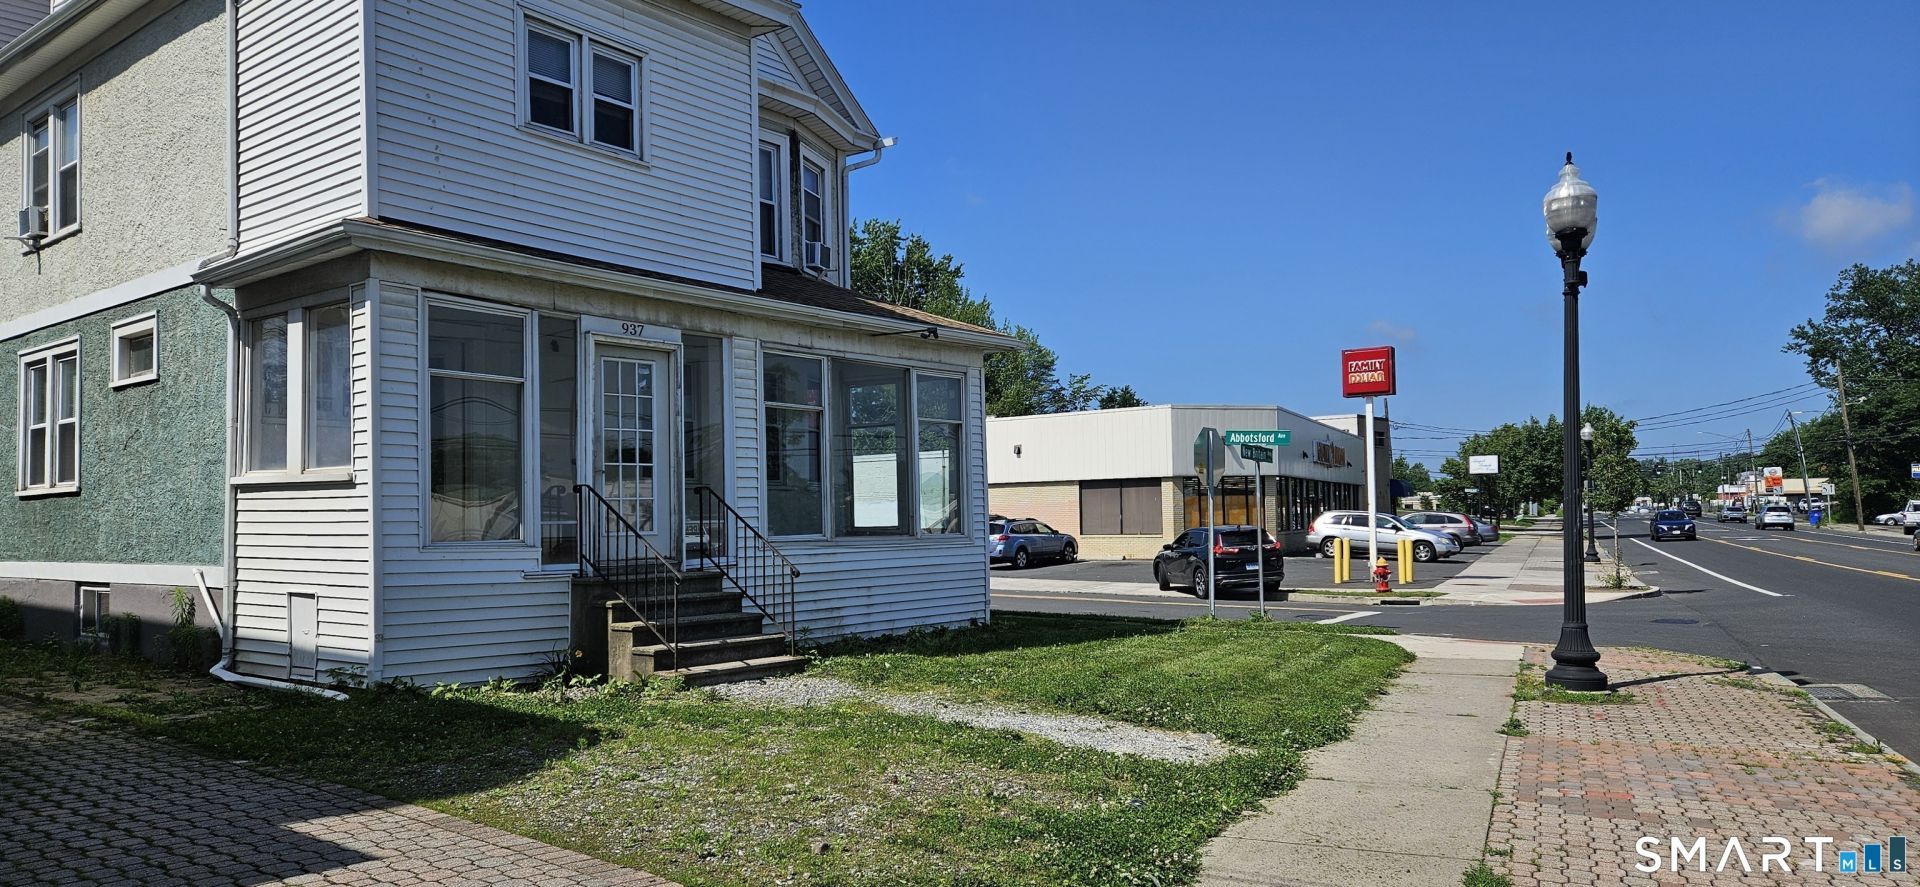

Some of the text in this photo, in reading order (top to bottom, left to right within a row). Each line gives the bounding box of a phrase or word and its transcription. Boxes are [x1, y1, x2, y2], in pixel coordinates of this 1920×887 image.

[621, 322, 645, 337] 937
[1348, 359, 1386, 372] FAMILY
[1230, 432, 1275, 443] Abbotsford
